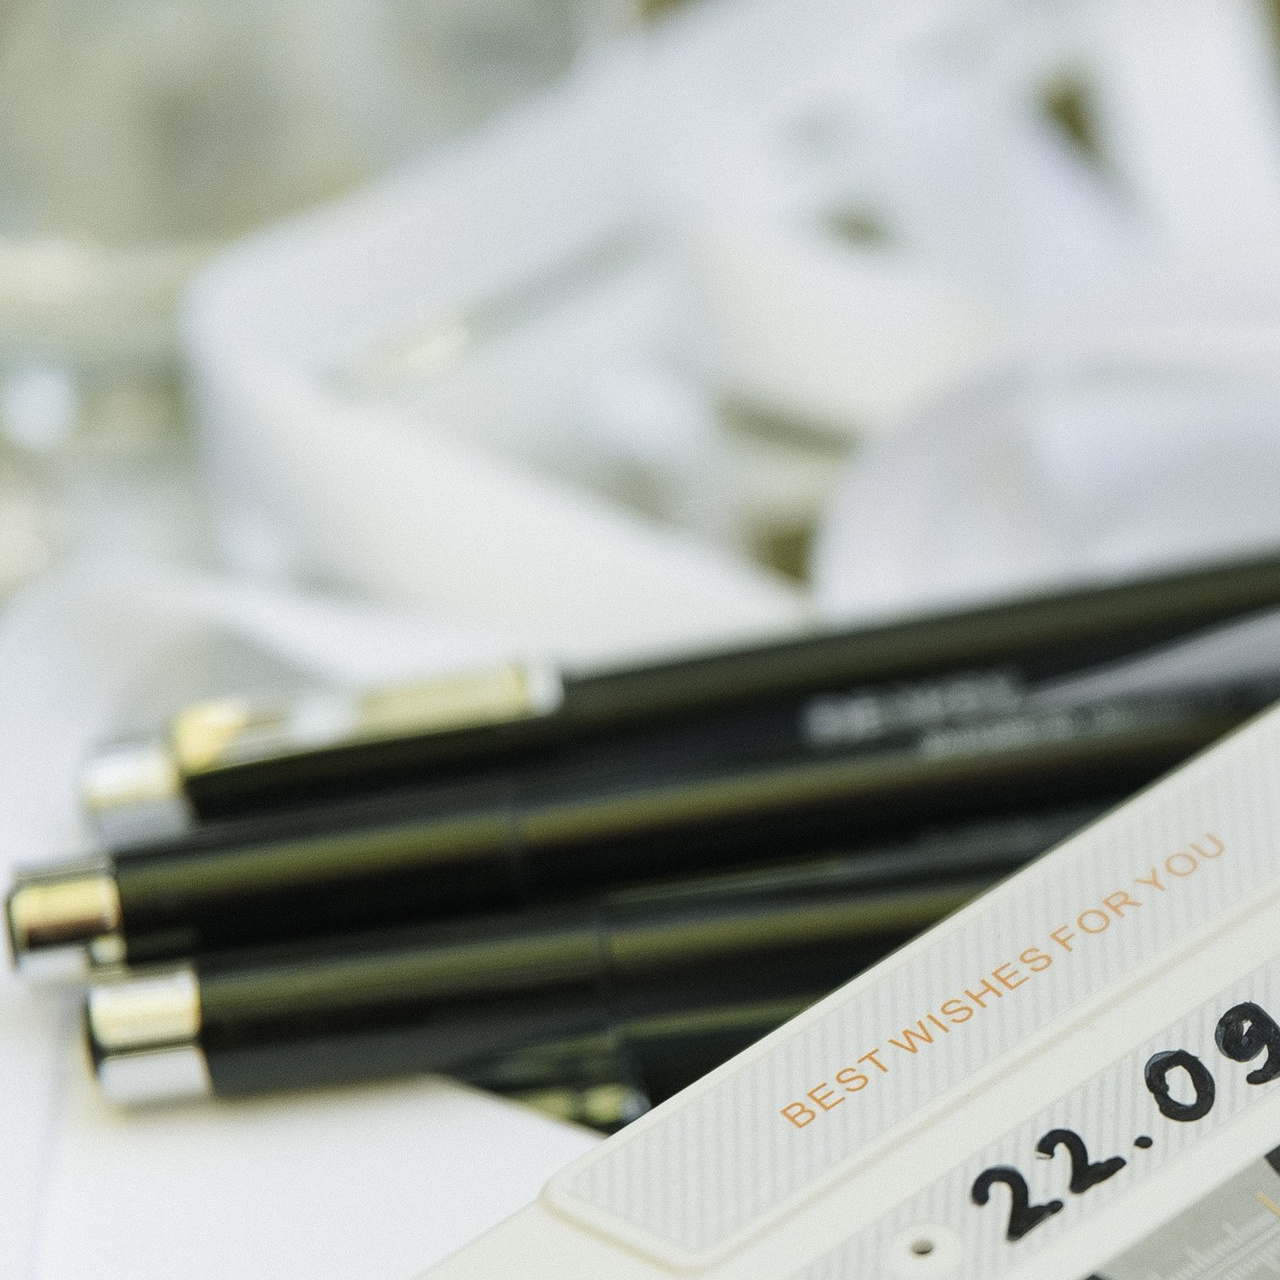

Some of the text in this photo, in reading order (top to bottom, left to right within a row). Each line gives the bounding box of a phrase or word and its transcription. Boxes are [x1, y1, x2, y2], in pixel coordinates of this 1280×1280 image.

[780, 832, 1227, 1129] BEST WISHES FOR YOU
